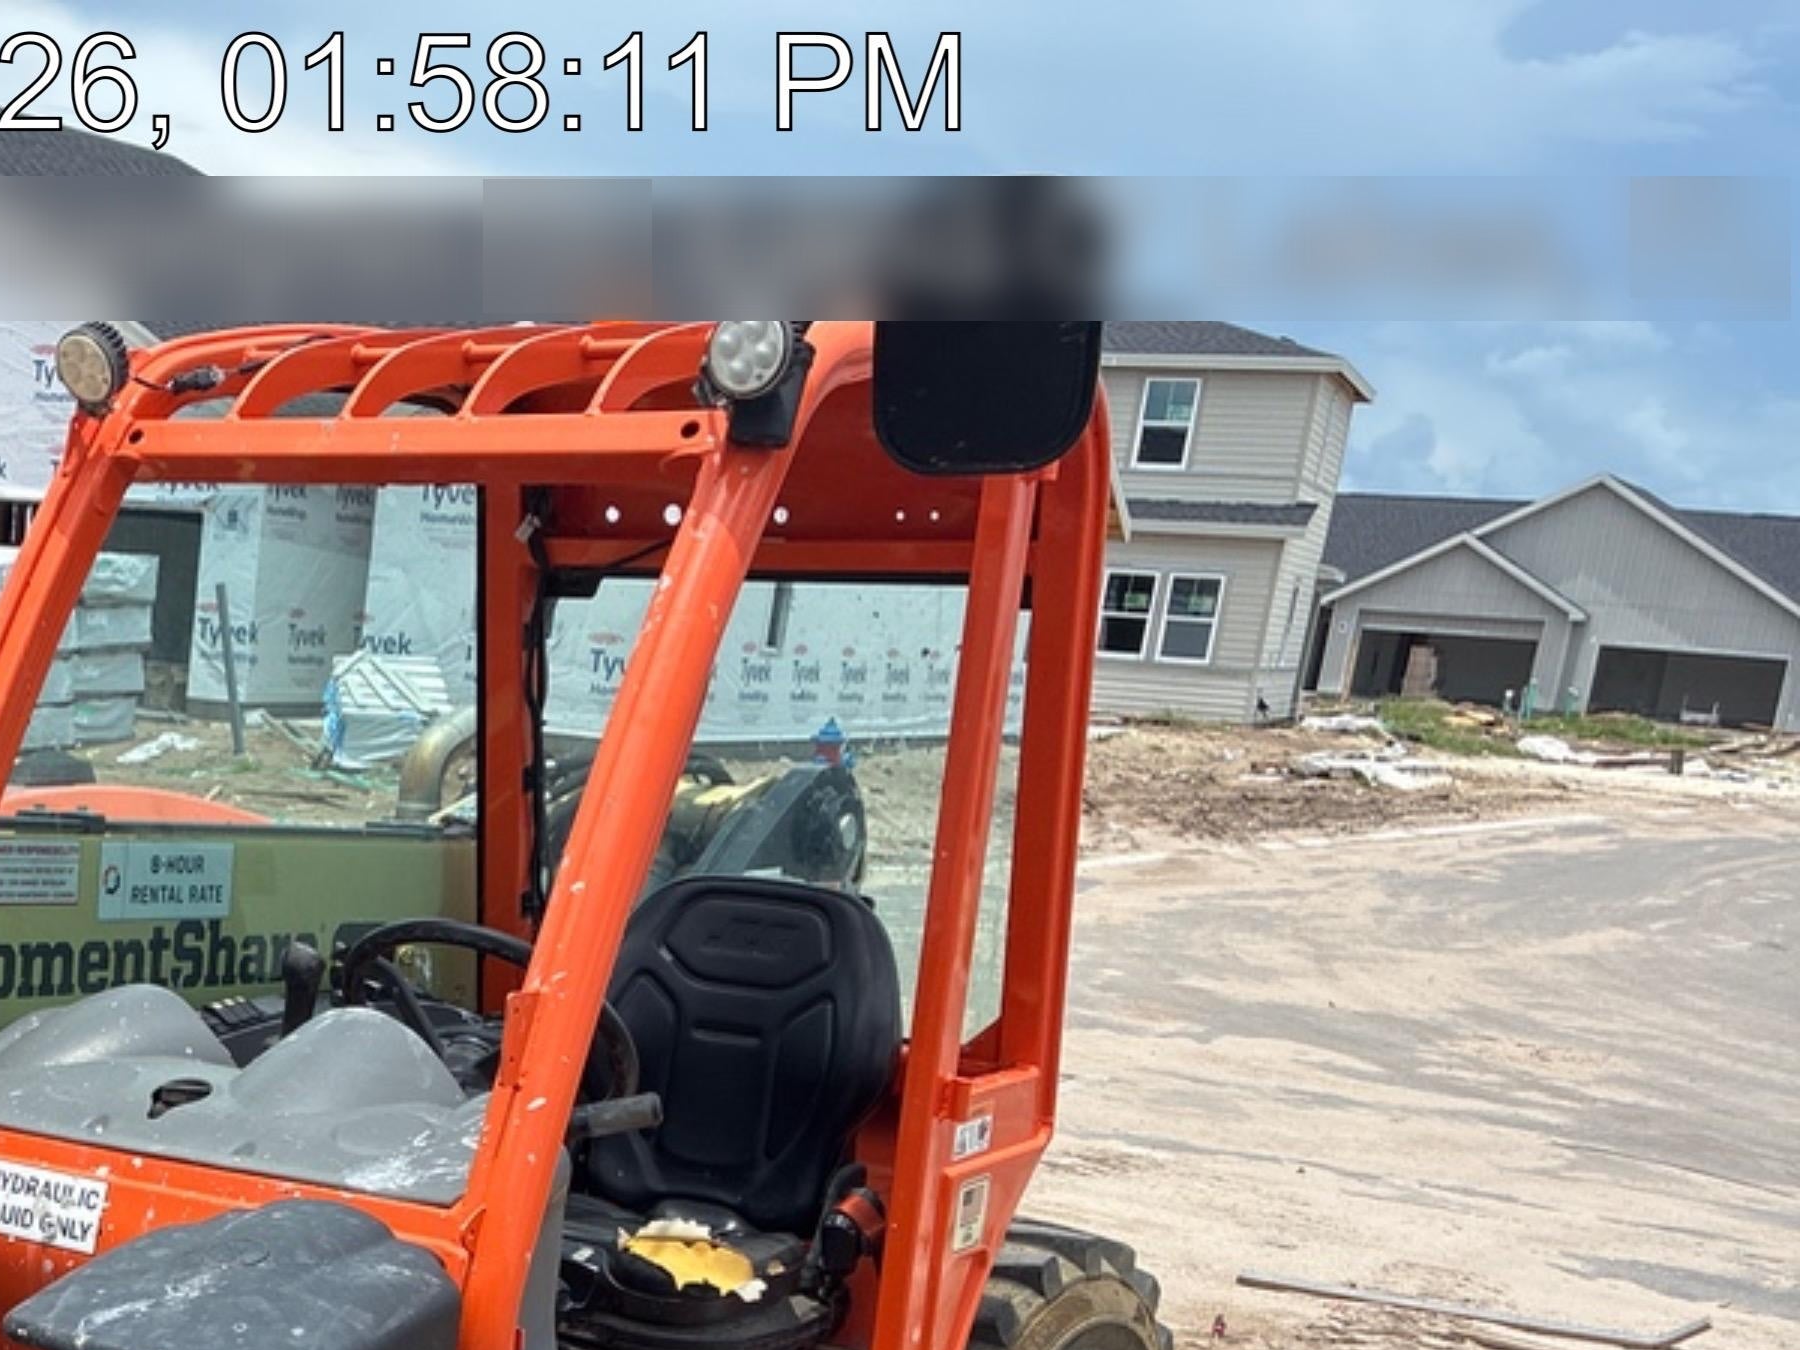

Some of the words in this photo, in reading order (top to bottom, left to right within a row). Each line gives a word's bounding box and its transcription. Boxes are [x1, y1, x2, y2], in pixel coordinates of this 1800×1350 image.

[198, 617, 258, 649] Tyek
[288, 622, 327, 651] Tyvek
[150, 854, 205, 875] 8-HOUR
[129, 885, 183, 906] RENTAL
[187, 884, 224, 905] RATE
